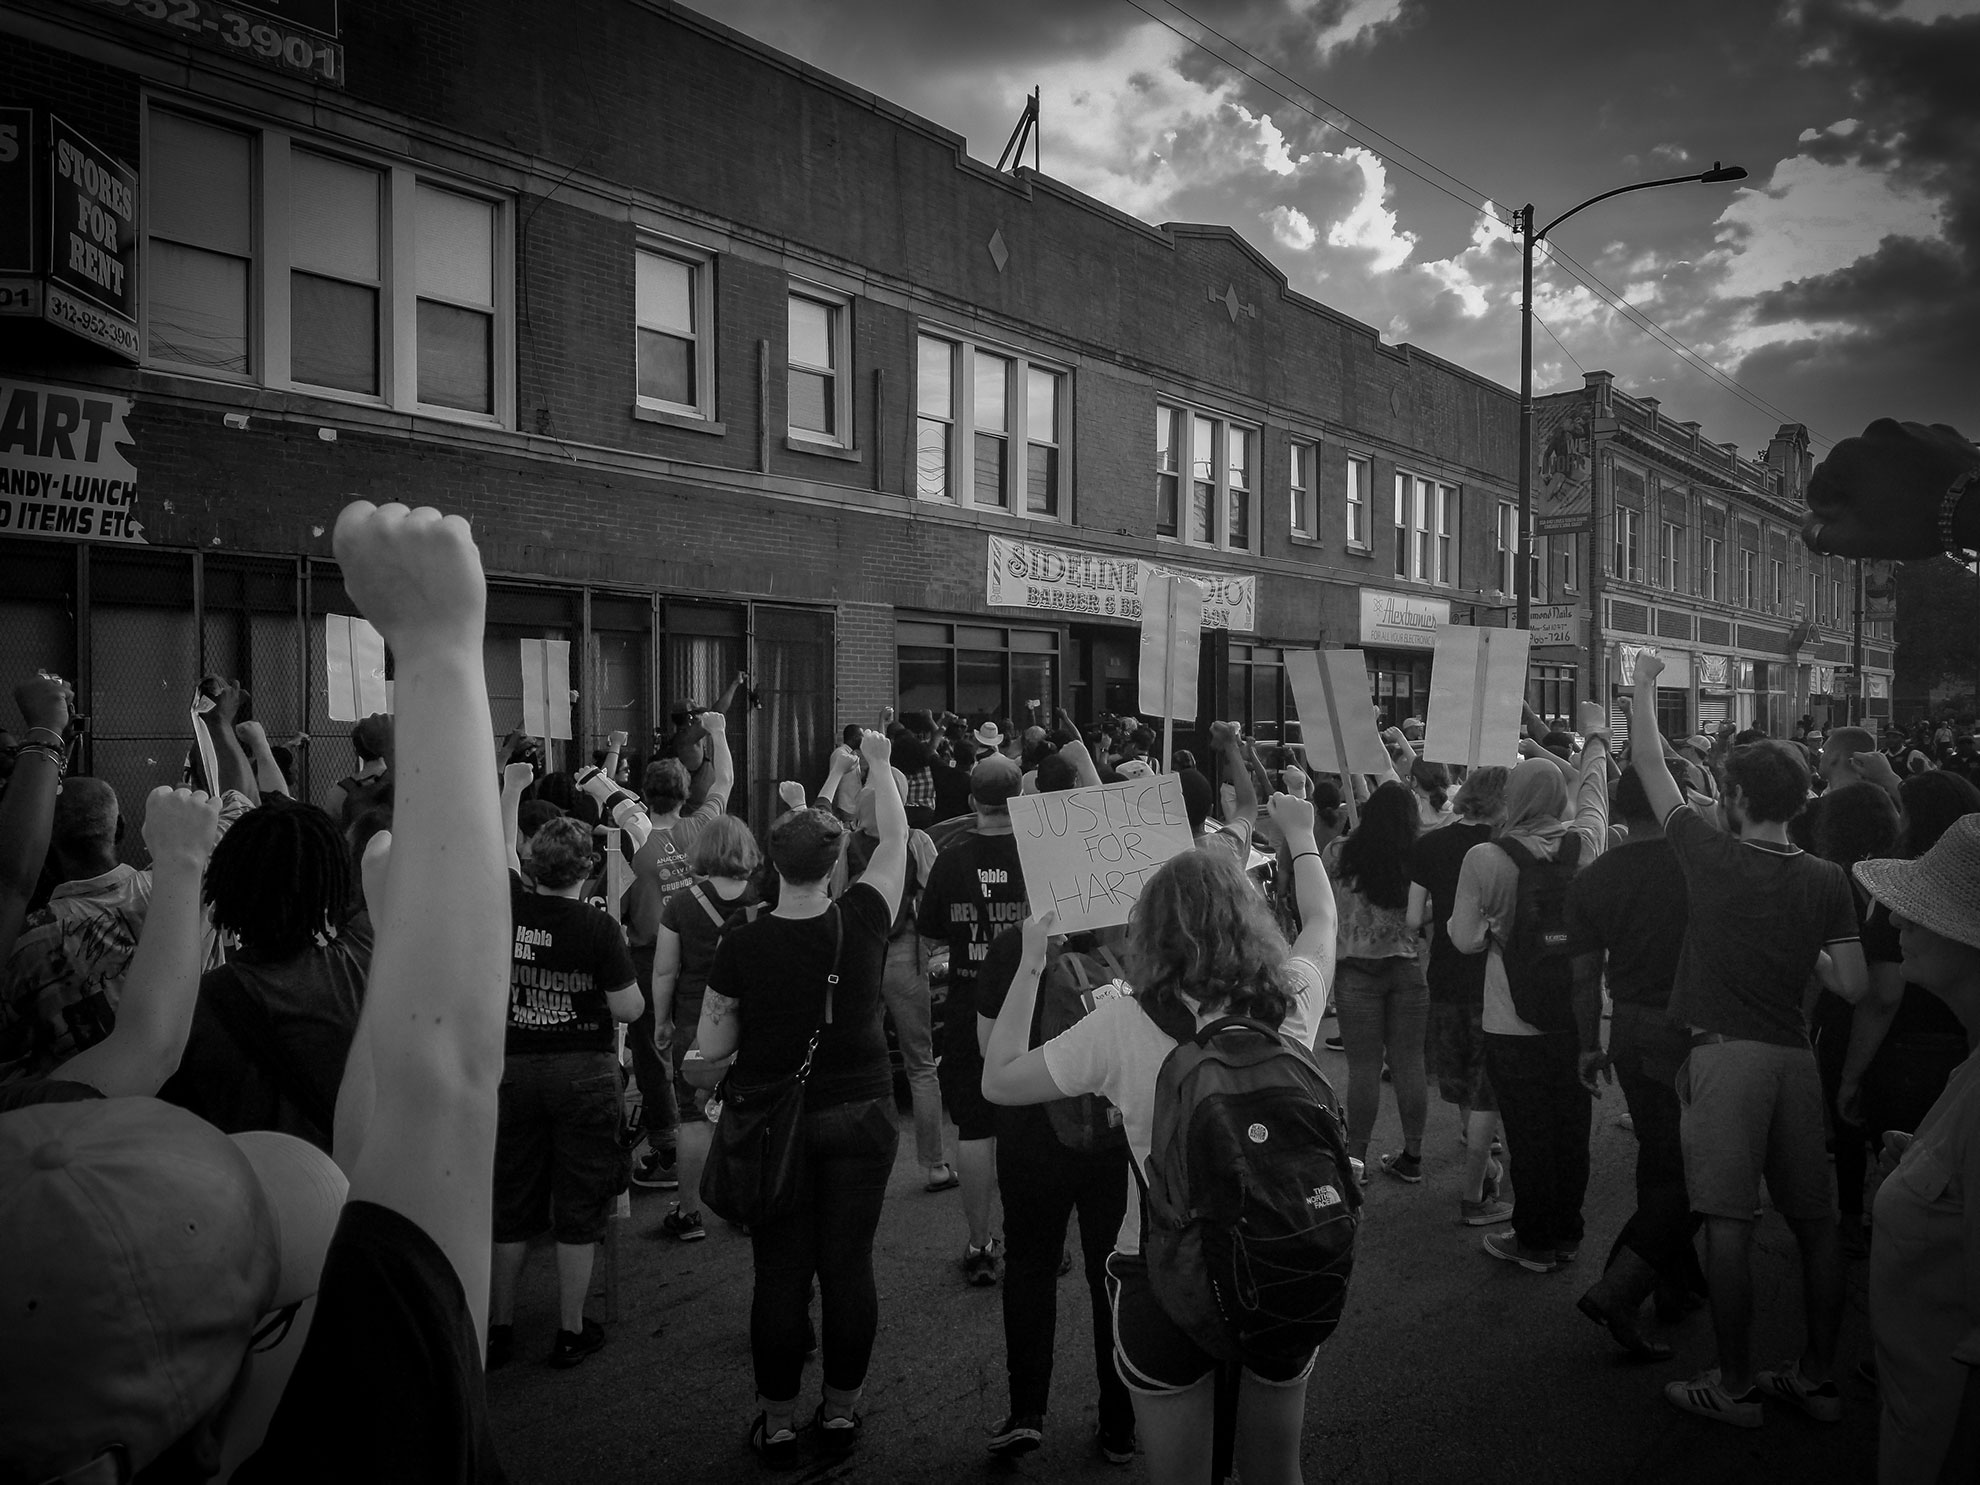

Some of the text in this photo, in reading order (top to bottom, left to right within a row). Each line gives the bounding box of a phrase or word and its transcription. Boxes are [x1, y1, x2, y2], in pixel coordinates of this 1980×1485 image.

[102, 0, 335, 80] 52-3901
[58, 138, 132, 222] STORES
[78, 194, 118, 254] FOR
[69, 231, 125, 296] RENT
[51, 296, 138, 351] 312-952-3901
[17, 502, 95, 535] ITEMS
[1007, 542, 1139, 595] SIDELINE
[1026, 585, 1101, 613] BARBER
[1553, 605, 1573, 620] Nails
[1027, 781, 1183, 838] JUSTICE
[1083, 832, 1152, 863] FOR
[514, 943, 536, 961] BA:
[516, 925, 553, 947] Habla
[525, 988, 573, 1012] NADA
[1306, 1193, 1330, 1205] NORTH
[1314, 1199, 1331, 1209] FACE
